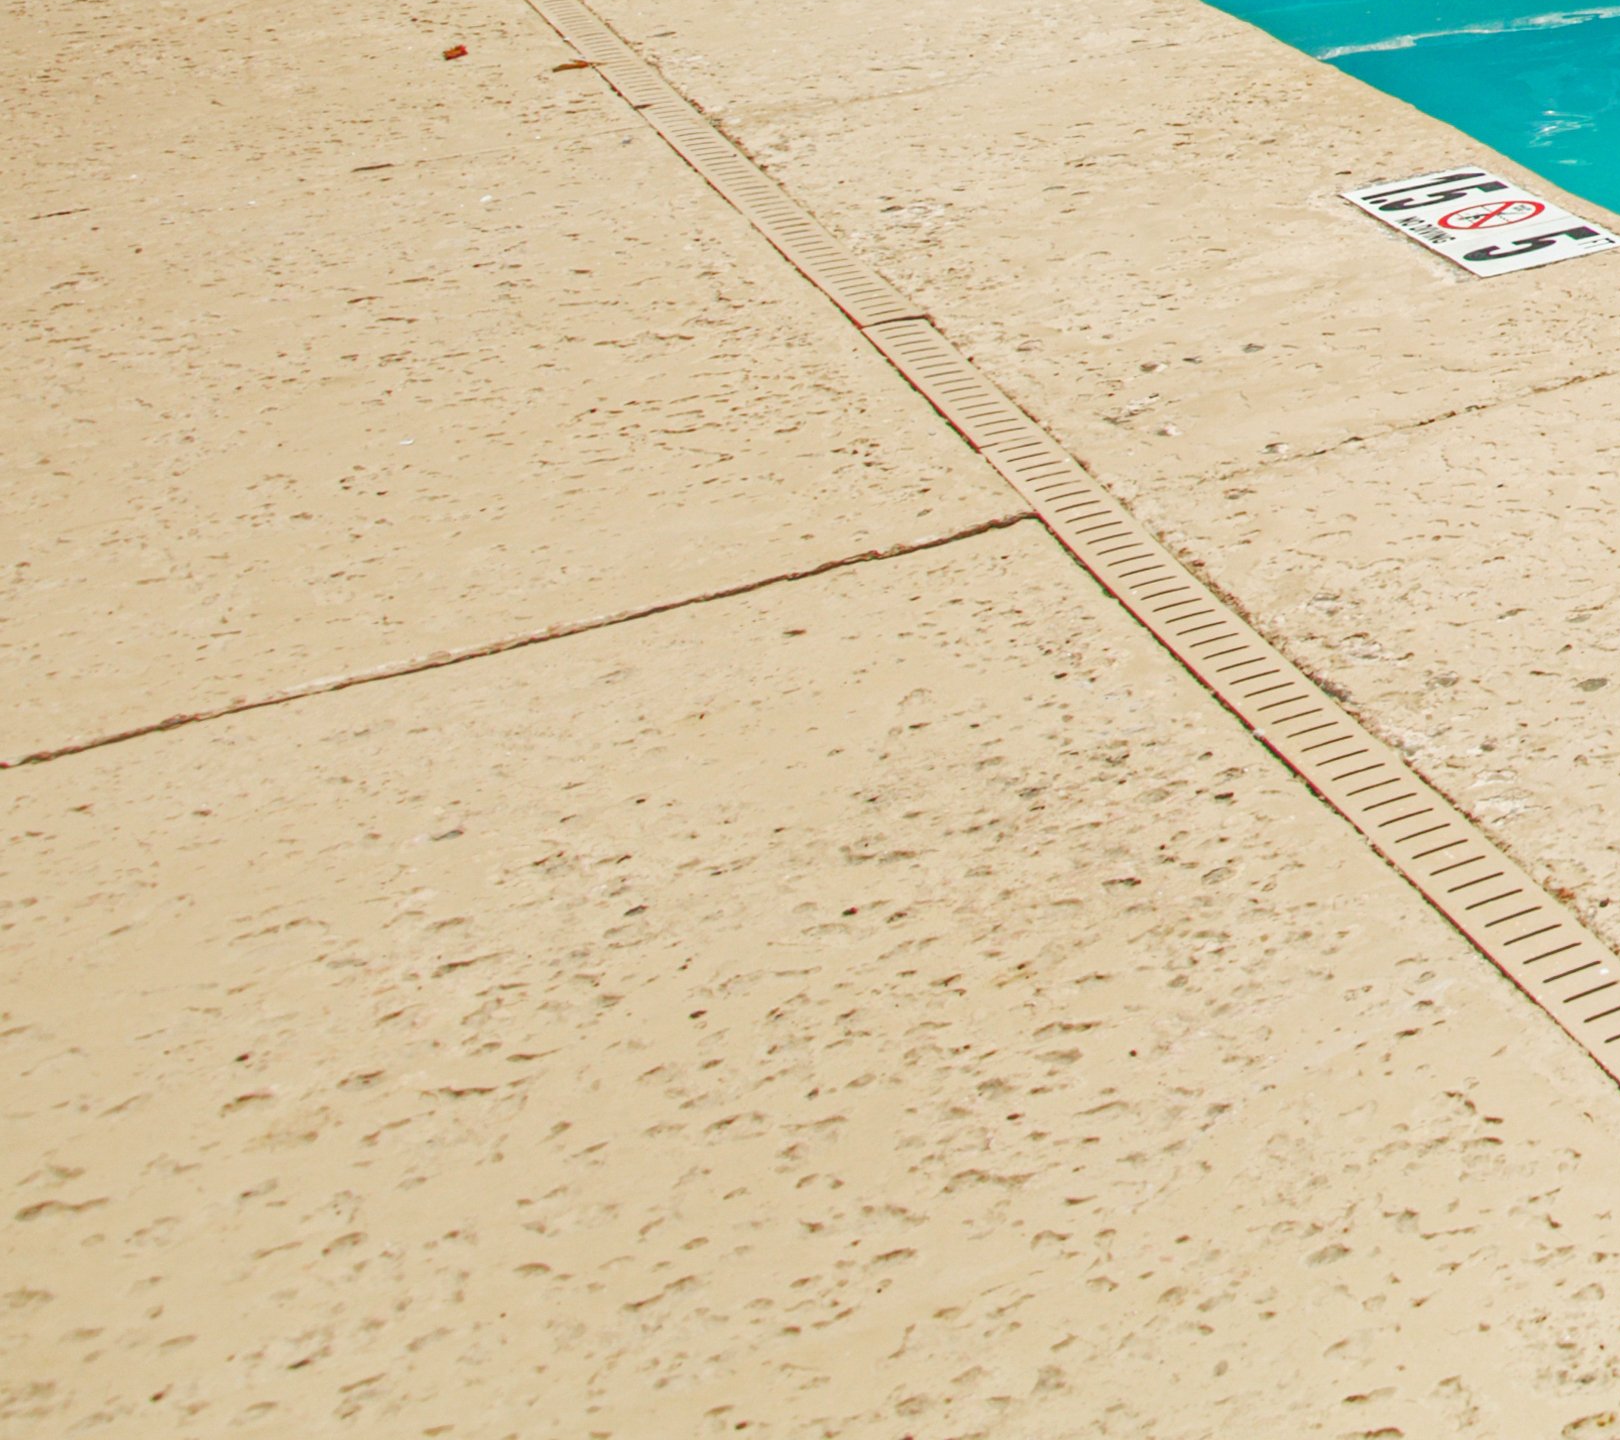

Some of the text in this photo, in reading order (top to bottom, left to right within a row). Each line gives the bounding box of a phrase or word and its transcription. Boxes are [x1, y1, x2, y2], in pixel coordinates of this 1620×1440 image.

[1395, 216, 1456, 244] NO DIVING
[1463, 226, 1600, 261] 5
